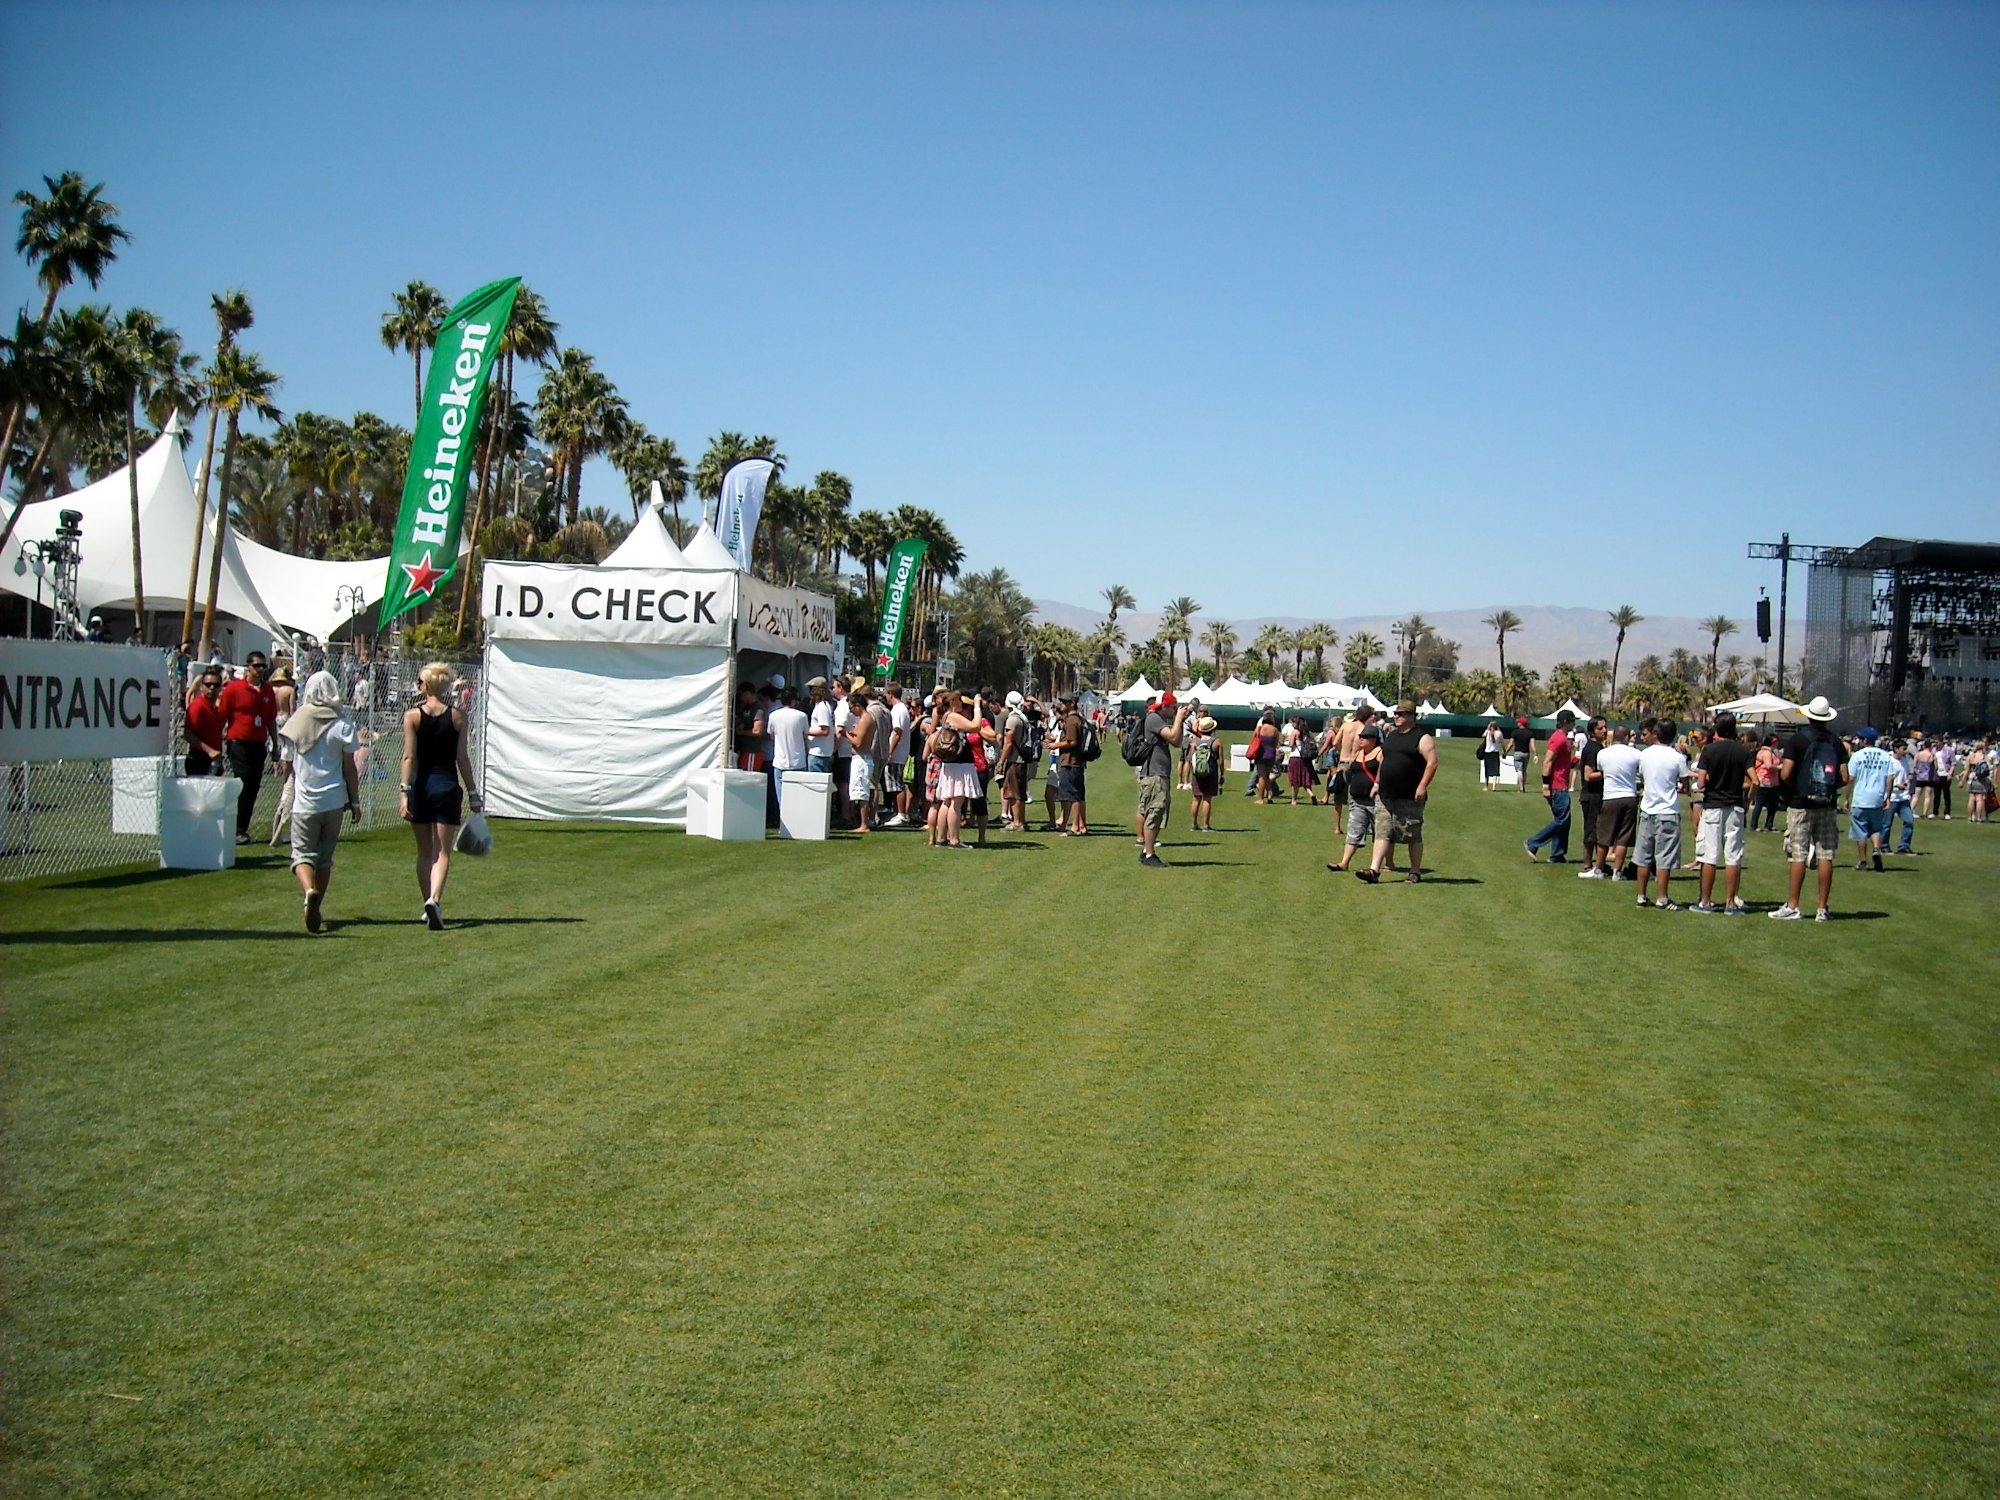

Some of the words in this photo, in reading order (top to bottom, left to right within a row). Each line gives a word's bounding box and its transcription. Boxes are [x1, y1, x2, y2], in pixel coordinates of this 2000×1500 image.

[412, 322, 491, 547] Heineken
[495, 585, 554, 618] I.D.
[571, 587, 717, 624] CHECK
[879, 555, 914, 648] Heineken
[0, 674, 161, 729] NTRANCE
